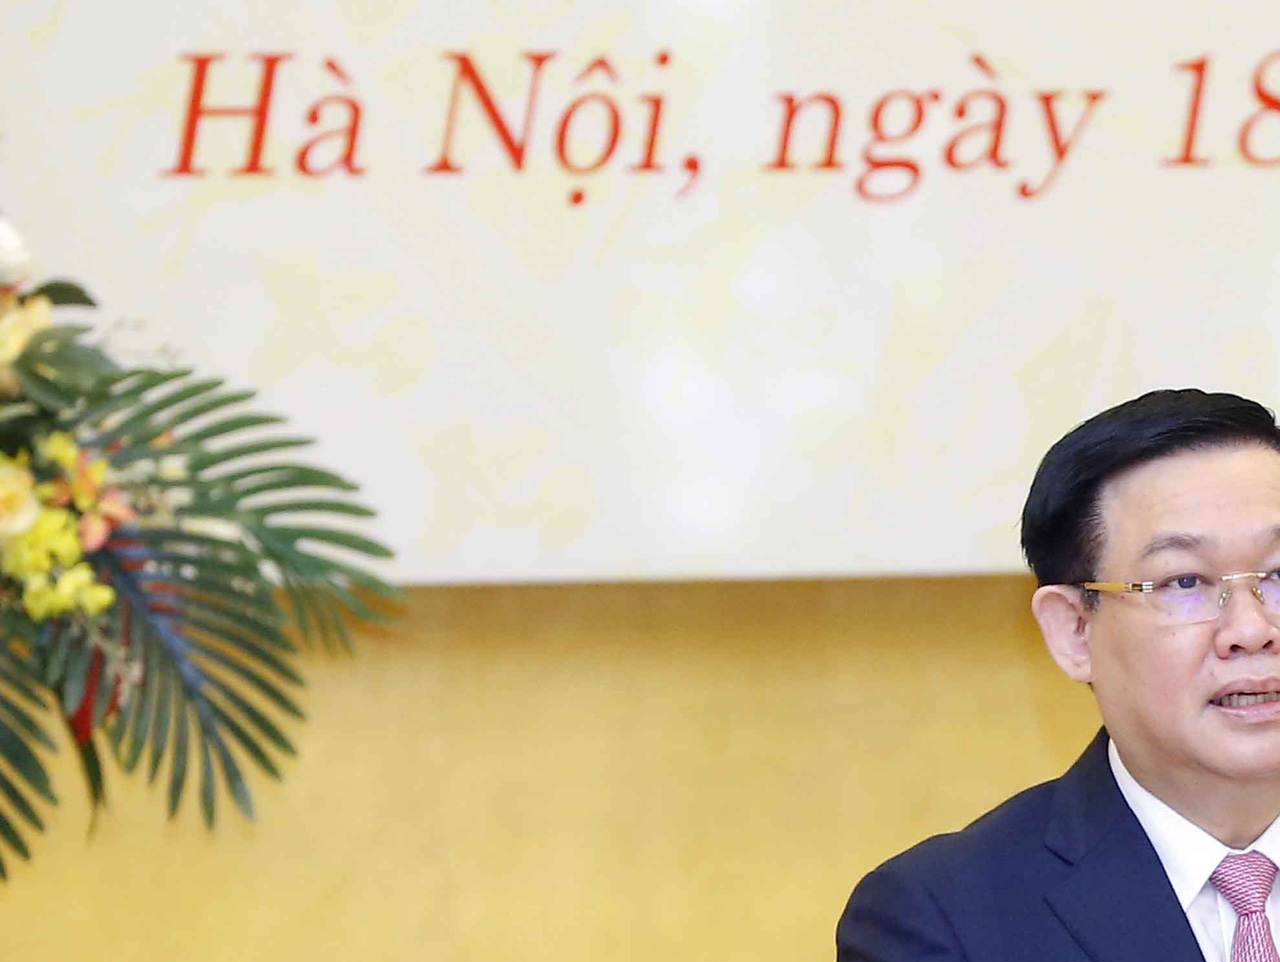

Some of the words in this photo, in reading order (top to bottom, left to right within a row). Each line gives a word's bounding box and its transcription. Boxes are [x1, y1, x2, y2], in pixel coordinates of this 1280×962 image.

[164, 52, 366, 180] Hà
[424, 50, 702, 207] Nội,
[766, 54, 1107, 202] ngày
